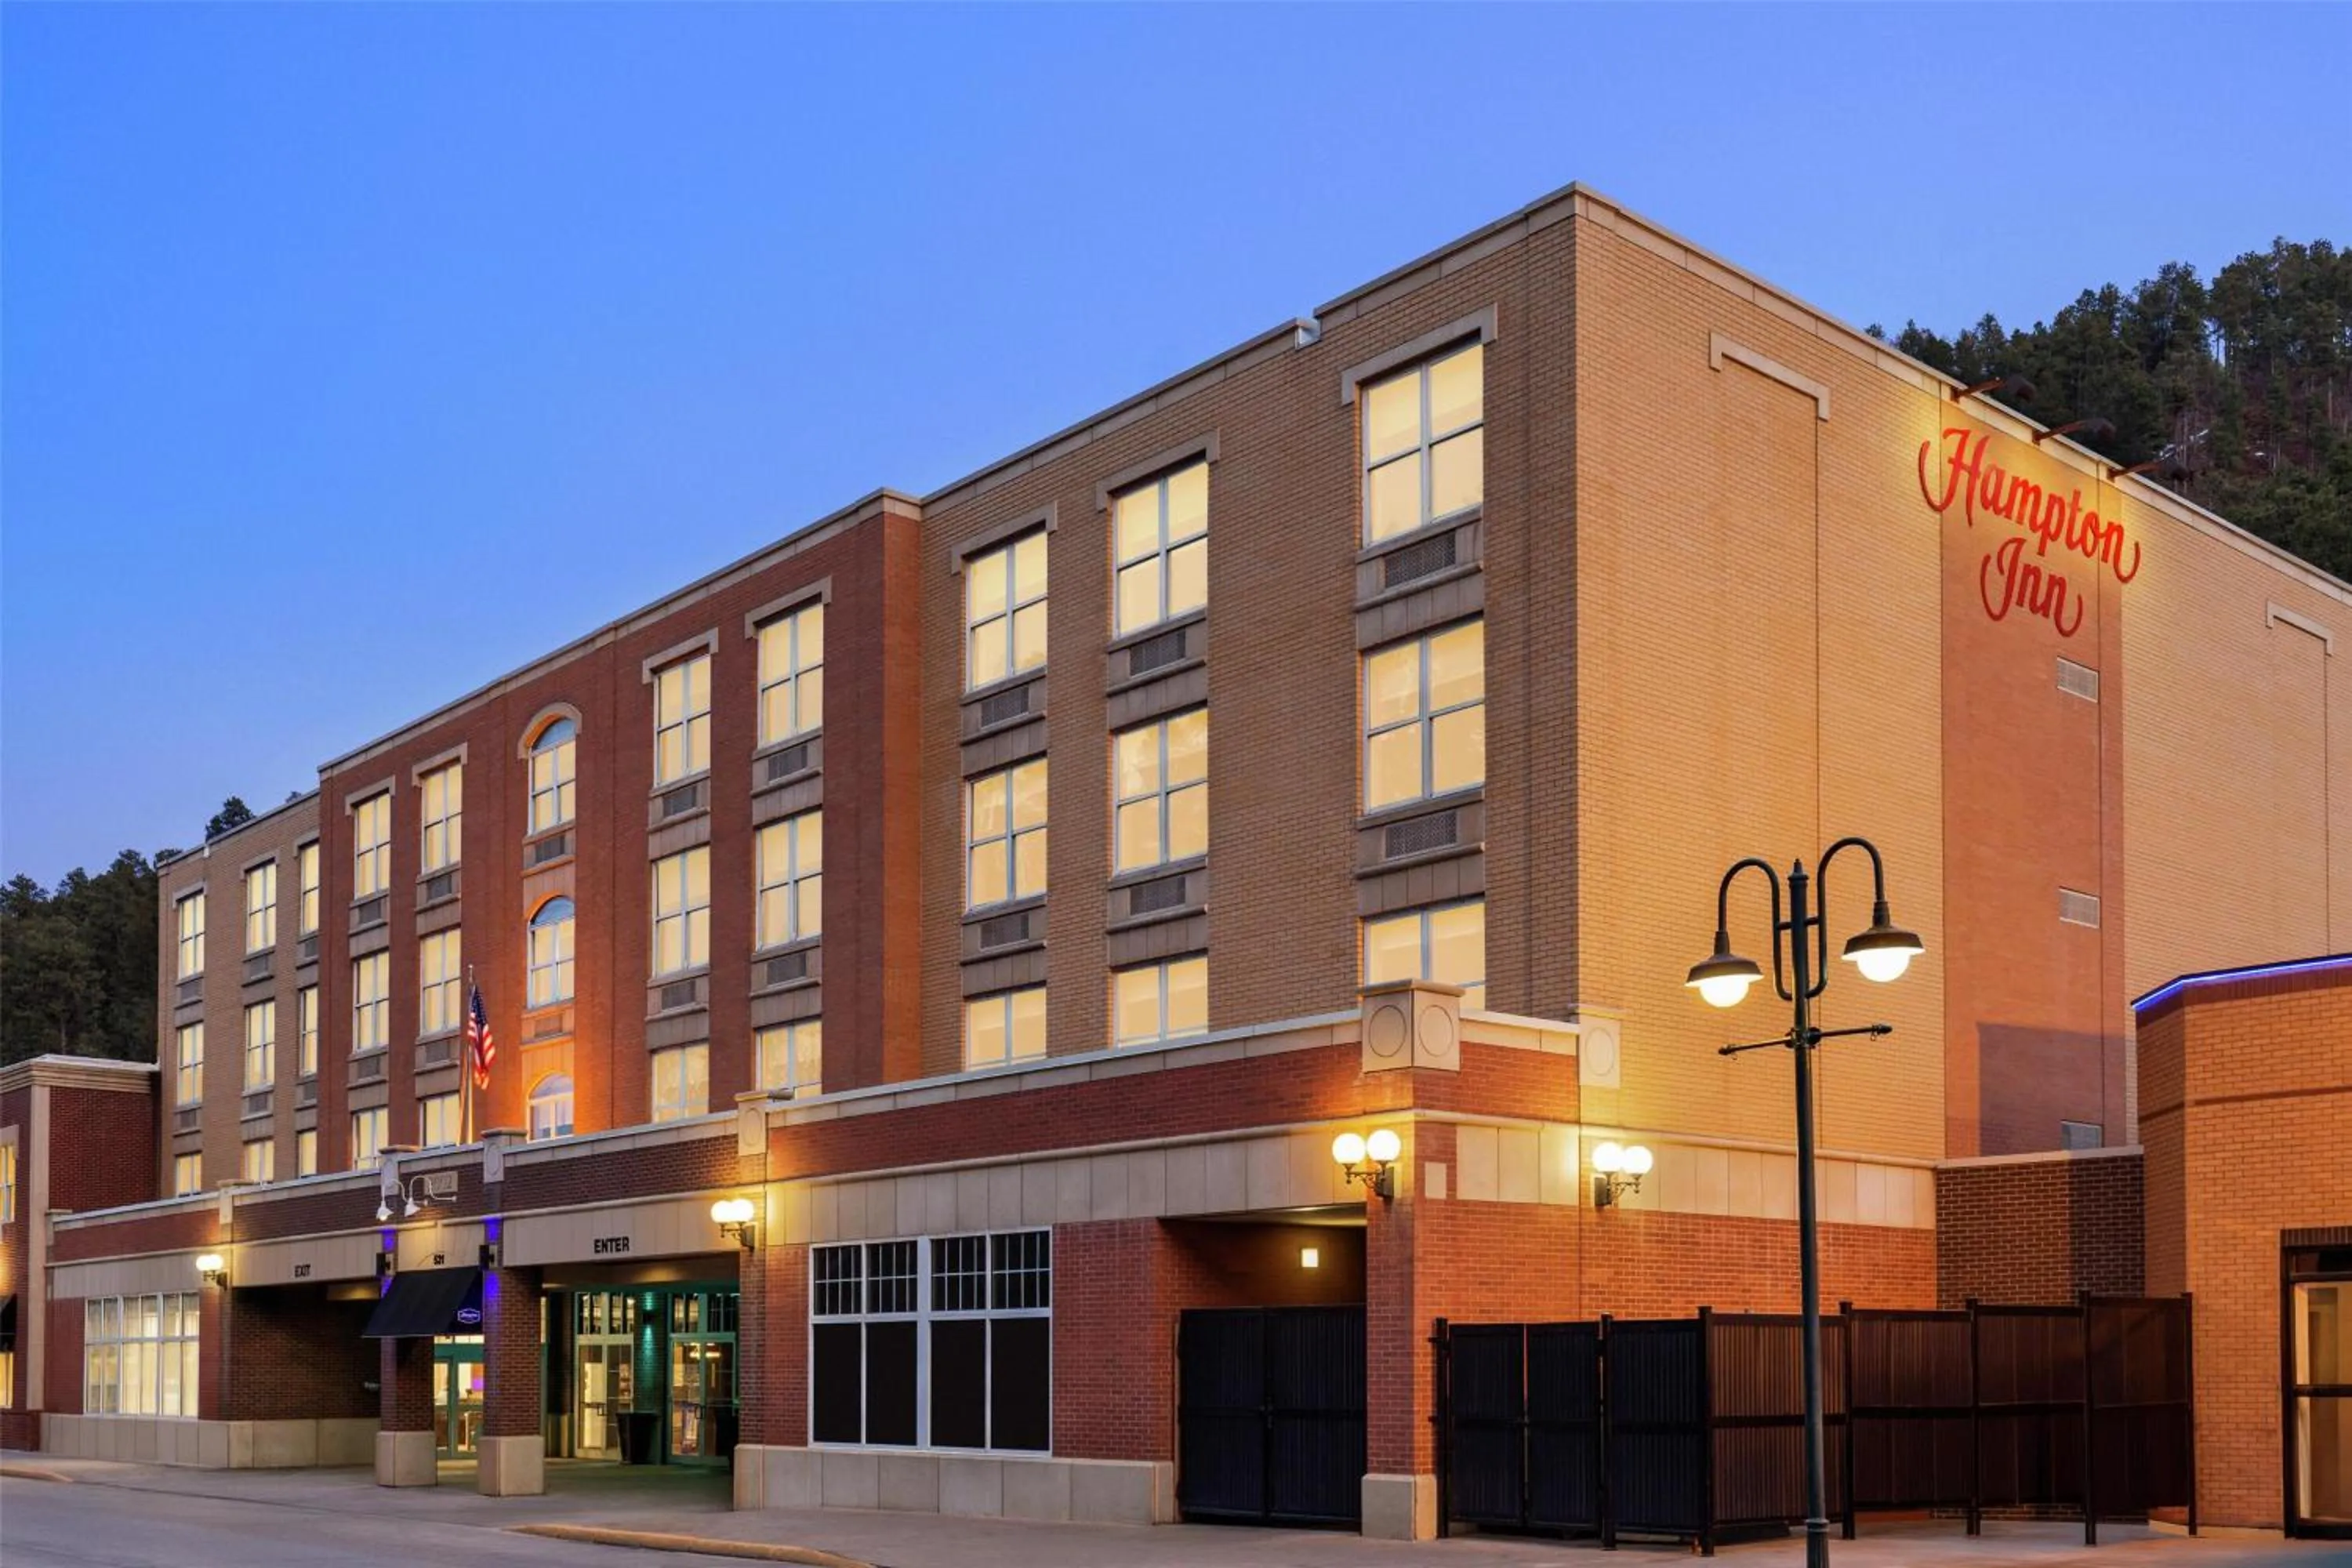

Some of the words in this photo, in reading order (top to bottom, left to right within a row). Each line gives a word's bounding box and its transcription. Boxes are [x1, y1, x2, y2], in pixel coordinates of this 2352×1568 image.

[1918, 427, 2140, 583] Hampton
[1980, 537, 2083, 637] Inn
[294, 1263, 311, 1277] EXIT
[593, 1236, 630, 1254] ENTER
